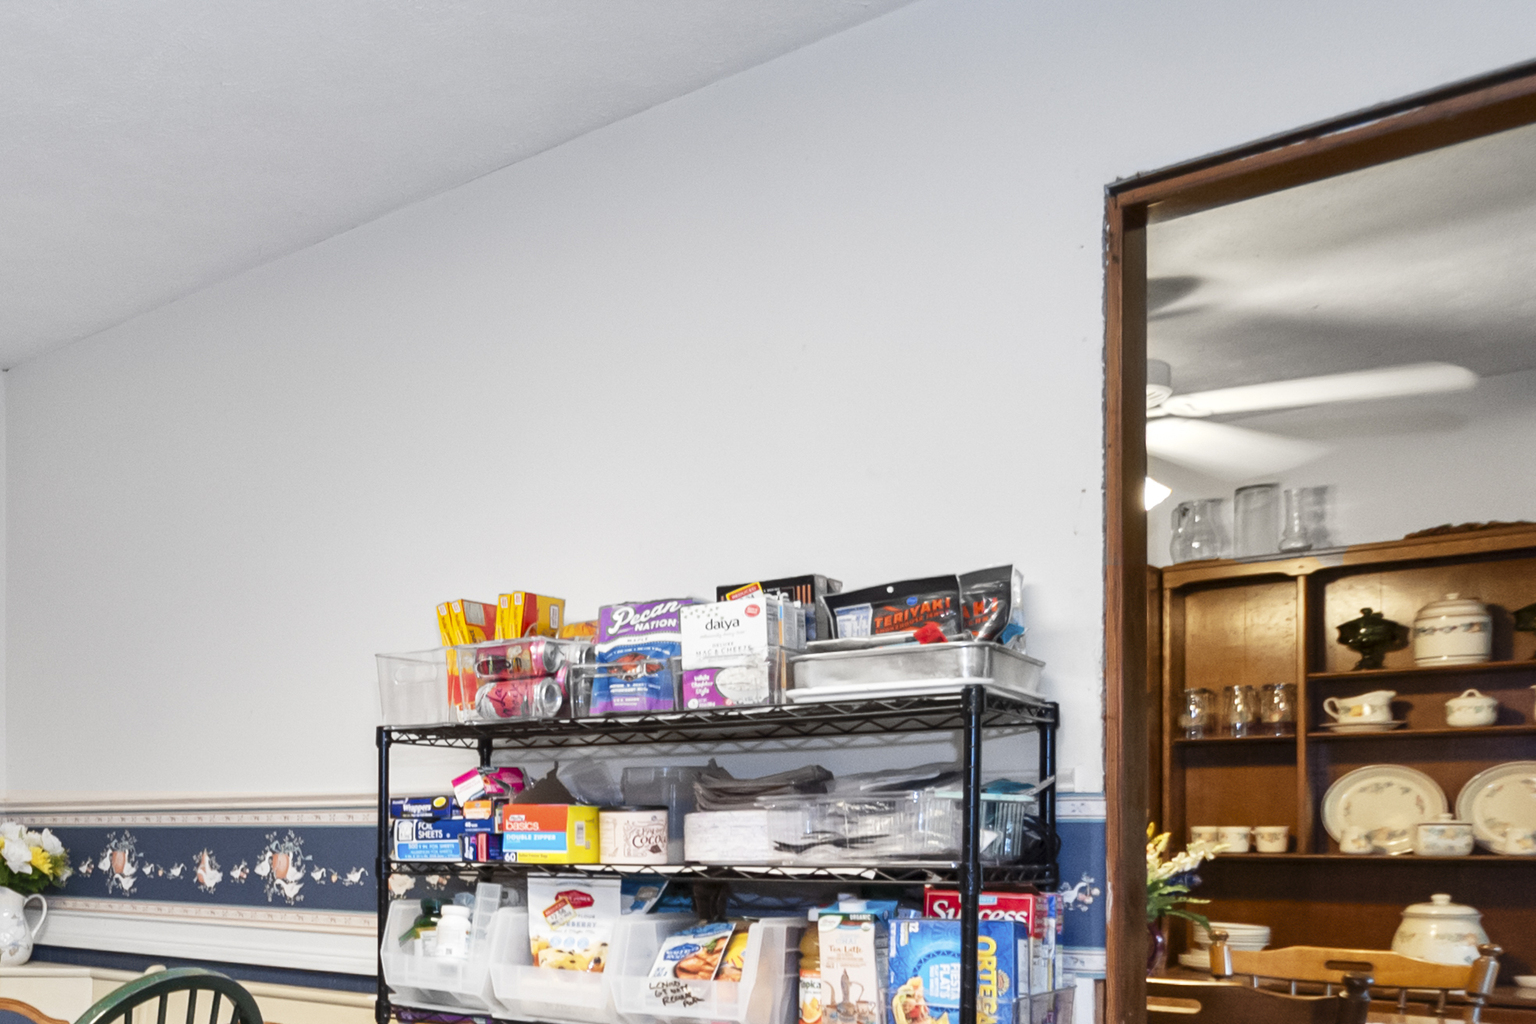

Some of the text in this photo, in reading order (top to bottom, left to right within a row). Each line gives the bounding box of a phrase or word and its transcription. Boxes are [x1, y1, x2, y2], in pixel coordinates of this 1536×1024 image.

[608, 600, 682, 635] Pecan
[874, 597, 951, 628] TERIYAKI
[634, 618, 678, 632] NATION
[705, 618, 740, 631] daiya
[505, 819, 540, 831] basics
[417, 829, 443, 839] SHEETS
[504, 852, 516, 862] 60
